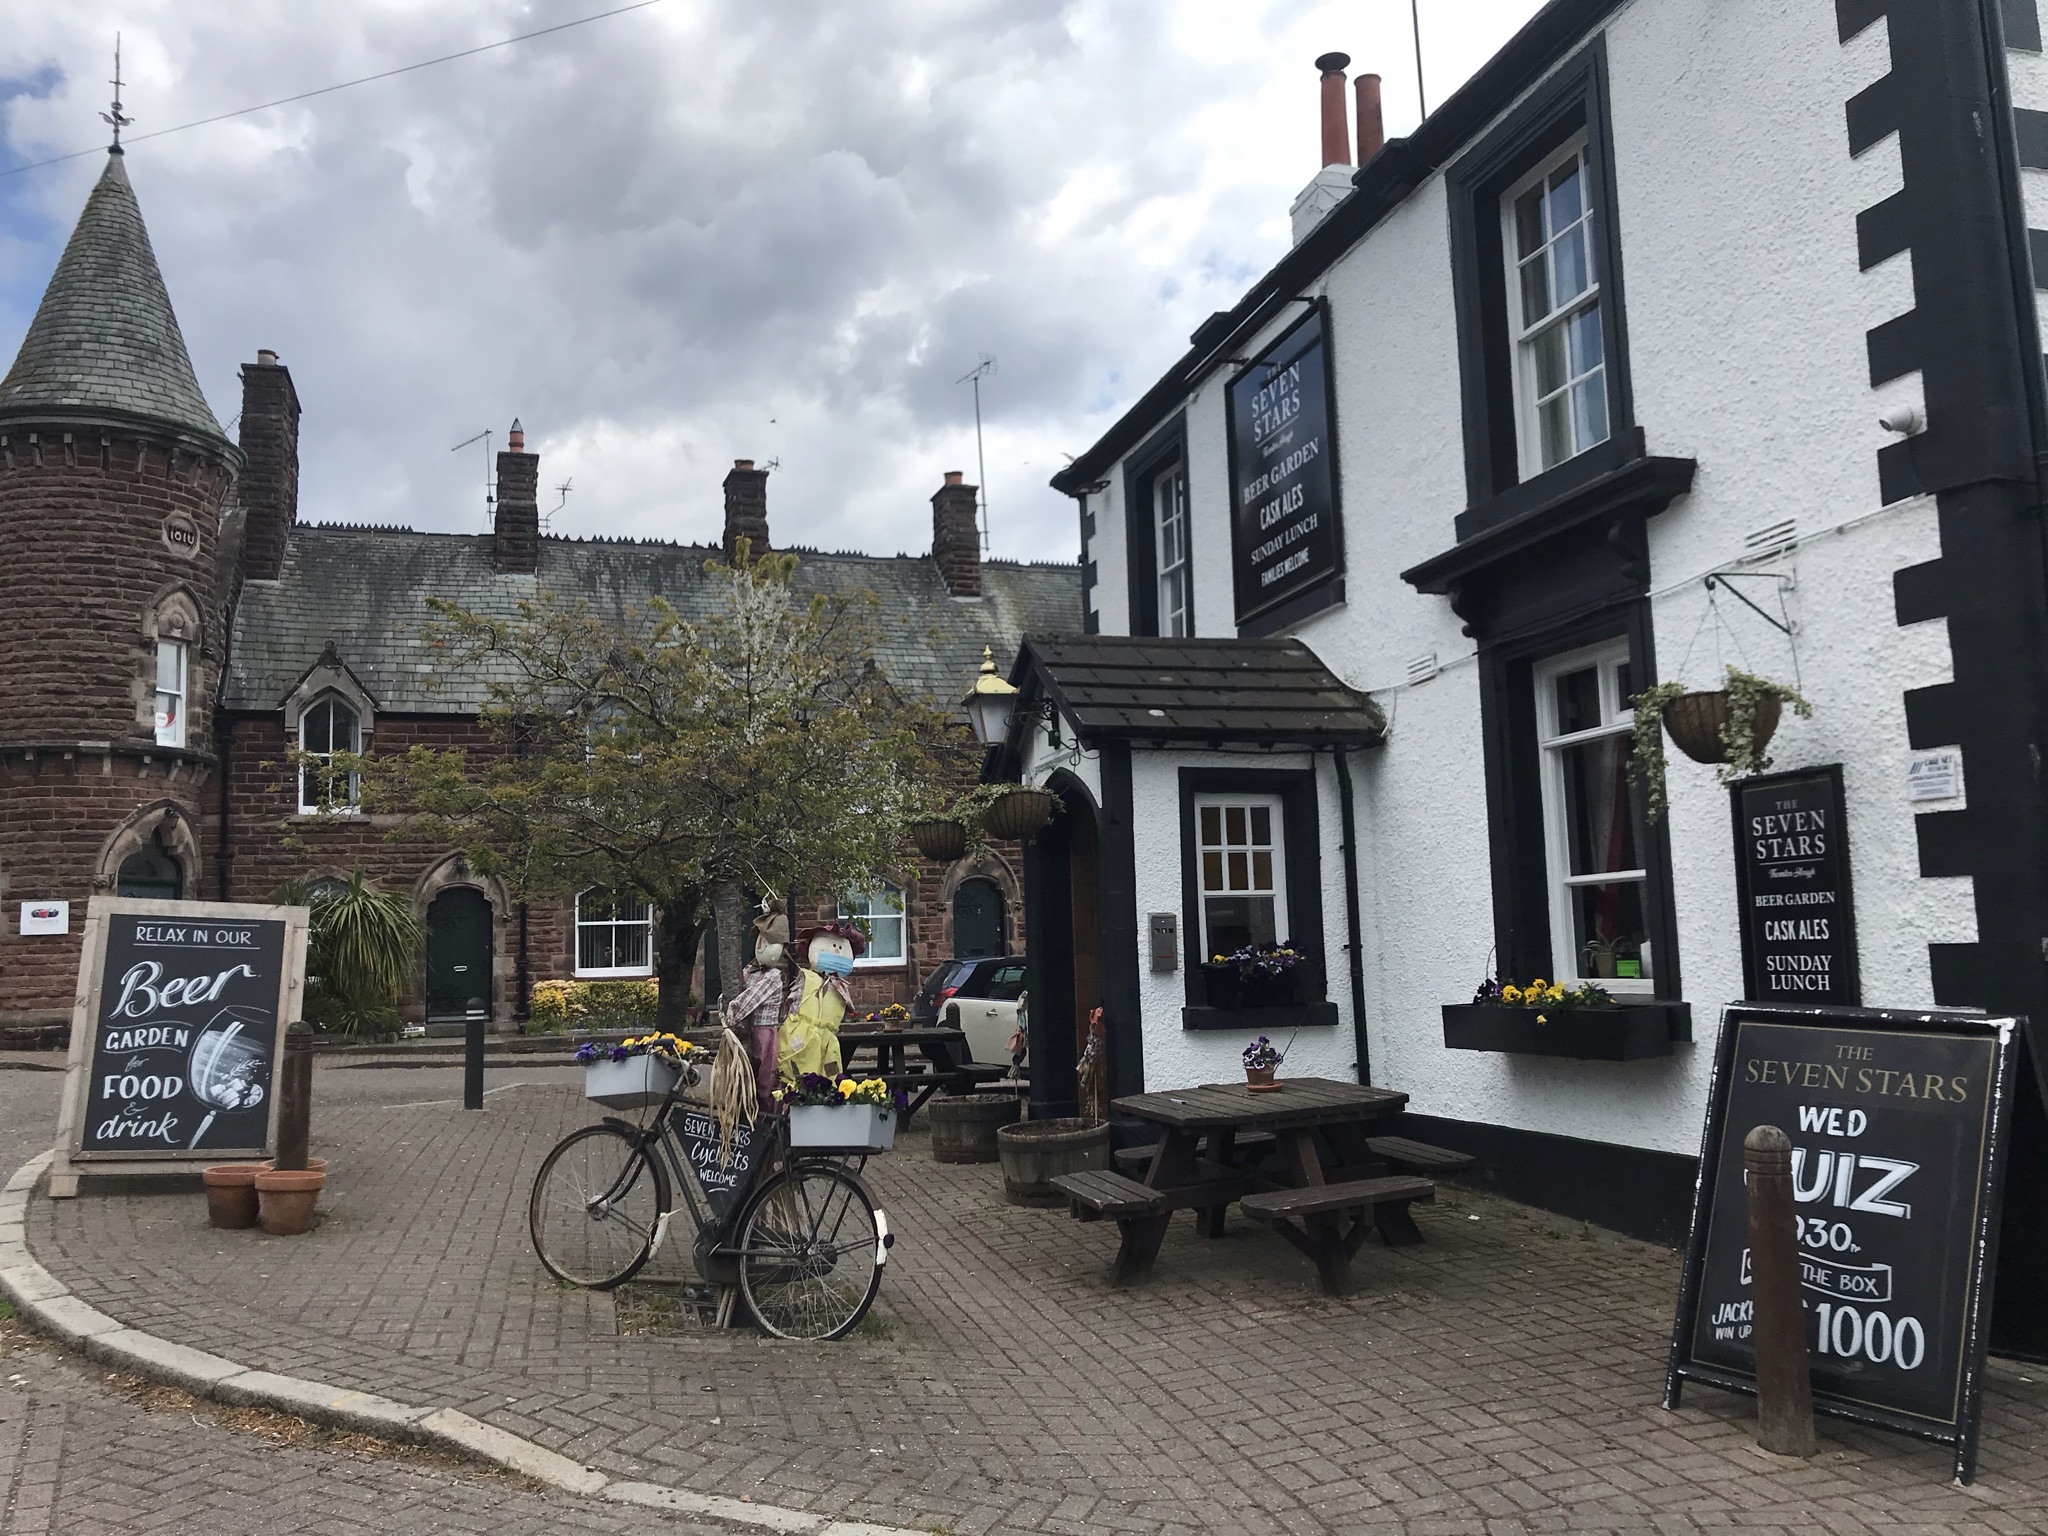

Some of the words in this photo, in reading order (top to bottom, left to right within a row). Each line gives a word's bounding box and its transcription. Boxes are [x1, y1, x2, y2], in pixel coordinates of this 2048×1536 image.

[1251, 361, 1300, 418] SEVEN
[1254, 389, 1300, 442] STARS
[1244, 473, 1270, 505] BEER
[1270, 437, 1319, 485] GARDEN
[1260, 497, 1281, 530] CASK
[1282, 483, 1304, 517] ALES
[1251, 533, 1284, 565] SUNDAY
[1285, 512, 1318, 545] LUNCH
[1775, 799, 1798, 811] THE
[1752, 809, 1825, 836] SEVEN
[1756, 834, 1825, 859] STARS
[1755, 894, 1784, 907] BEER
[1785, 891, 1835, 905] GARDEN
[136, 926, 187, 942] RELAX
[193, 929, 208, 943] IN
[215, 930, 252, 944] OUR
[1765, 920, 1796, 940] CASK
[1799, 919, 1829, 940] ALES
[1766, 955, 1832, 971] SUNDAY
[108, 960, 261, 1019] Beer
[1770, 974, 1830, 991] LUNCH
[105, 1027, 189, 1050] GARDEN
[125, 1055, 149, 1072] for
[1835, 1044, 1874, 1061] THE
[102, 1075, 183, 1100] FOOD
[1745, 1059, 1849, 1090] SEVEN
[1855, 1067, 1968, 1103] STARS
[123, 1102, 149, 1116] &
[1799, 1105, 1867, 1138] WED
[96, 1112, 180, 1144] drink
[684, 1118, 715, 1137] SEVEN
[691, 1140, 749, 1171] Cyclsts
[699, 1168, 738, 1187] WELCOME
[1744, 1147, 1920, 1219] UIZ
[1799, 1262, 1832, 1287] THE
[1839, 1274, 1879, 1296] BOX
[1715, 1326, 1735, 1340] WIN
[1739, 1325, 1752, 1338] UP
[1802, 1299, 1925, 1370] 1000
